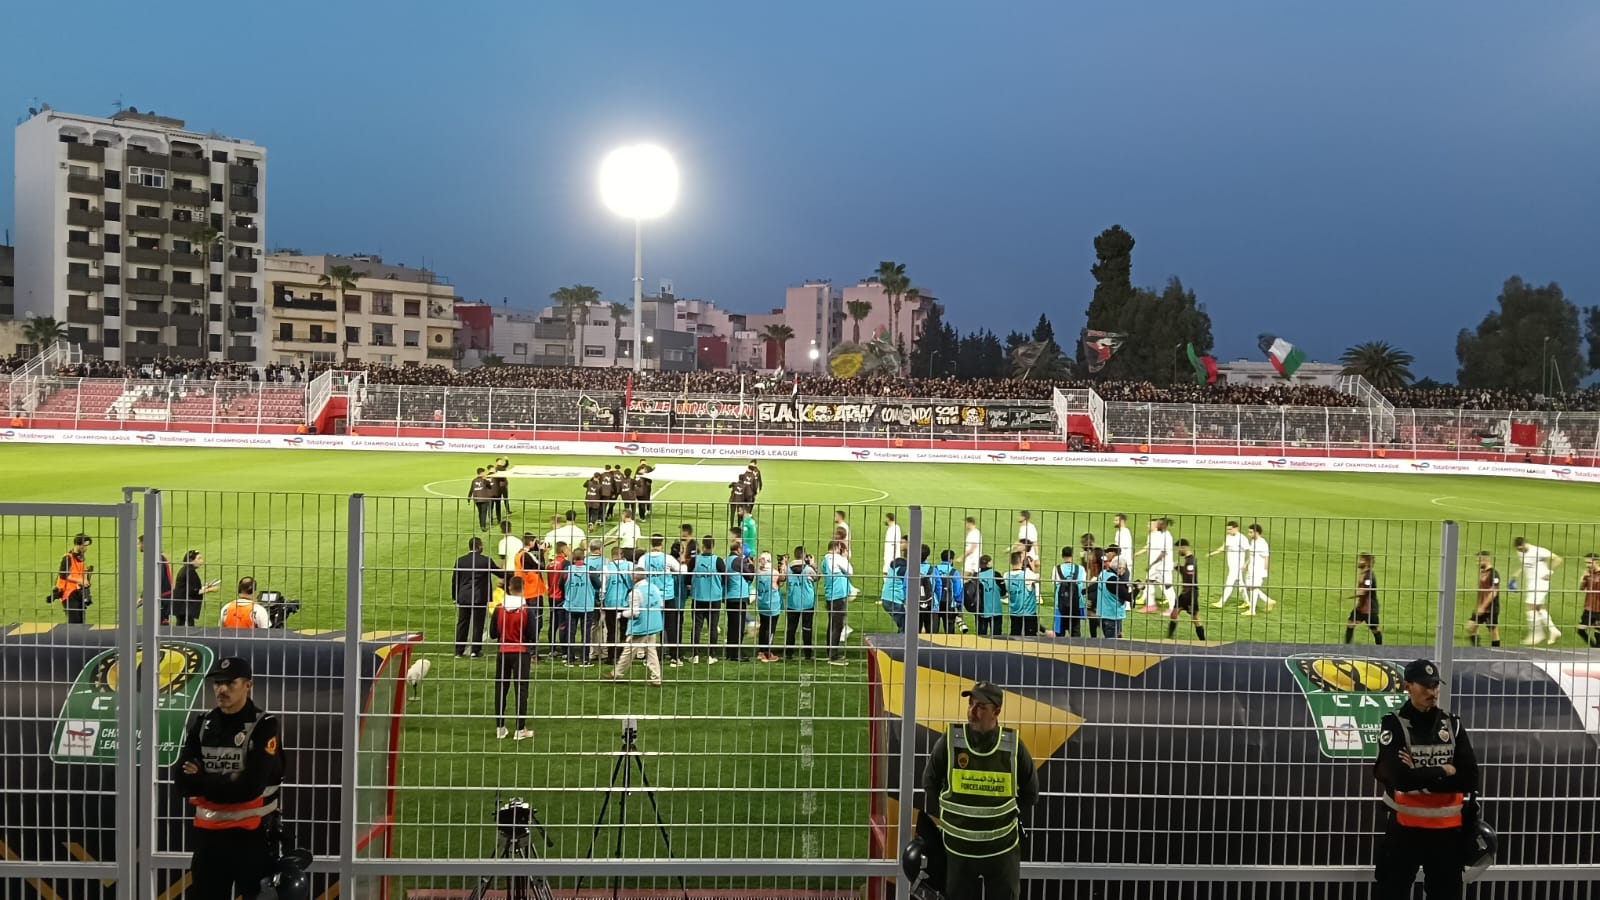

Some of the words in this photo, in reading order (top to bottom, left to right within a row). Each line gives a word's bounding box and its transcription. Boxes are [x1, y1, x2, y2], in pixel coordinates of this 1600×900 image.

[834, 404, 877, 422] ARMY
[641, 446, 695, 455] TotalEnergies
[91, 696, 167, 711] CF
[1332, 695, 1402, 708] CAF
[205, 761, 241, 770] OLICE
